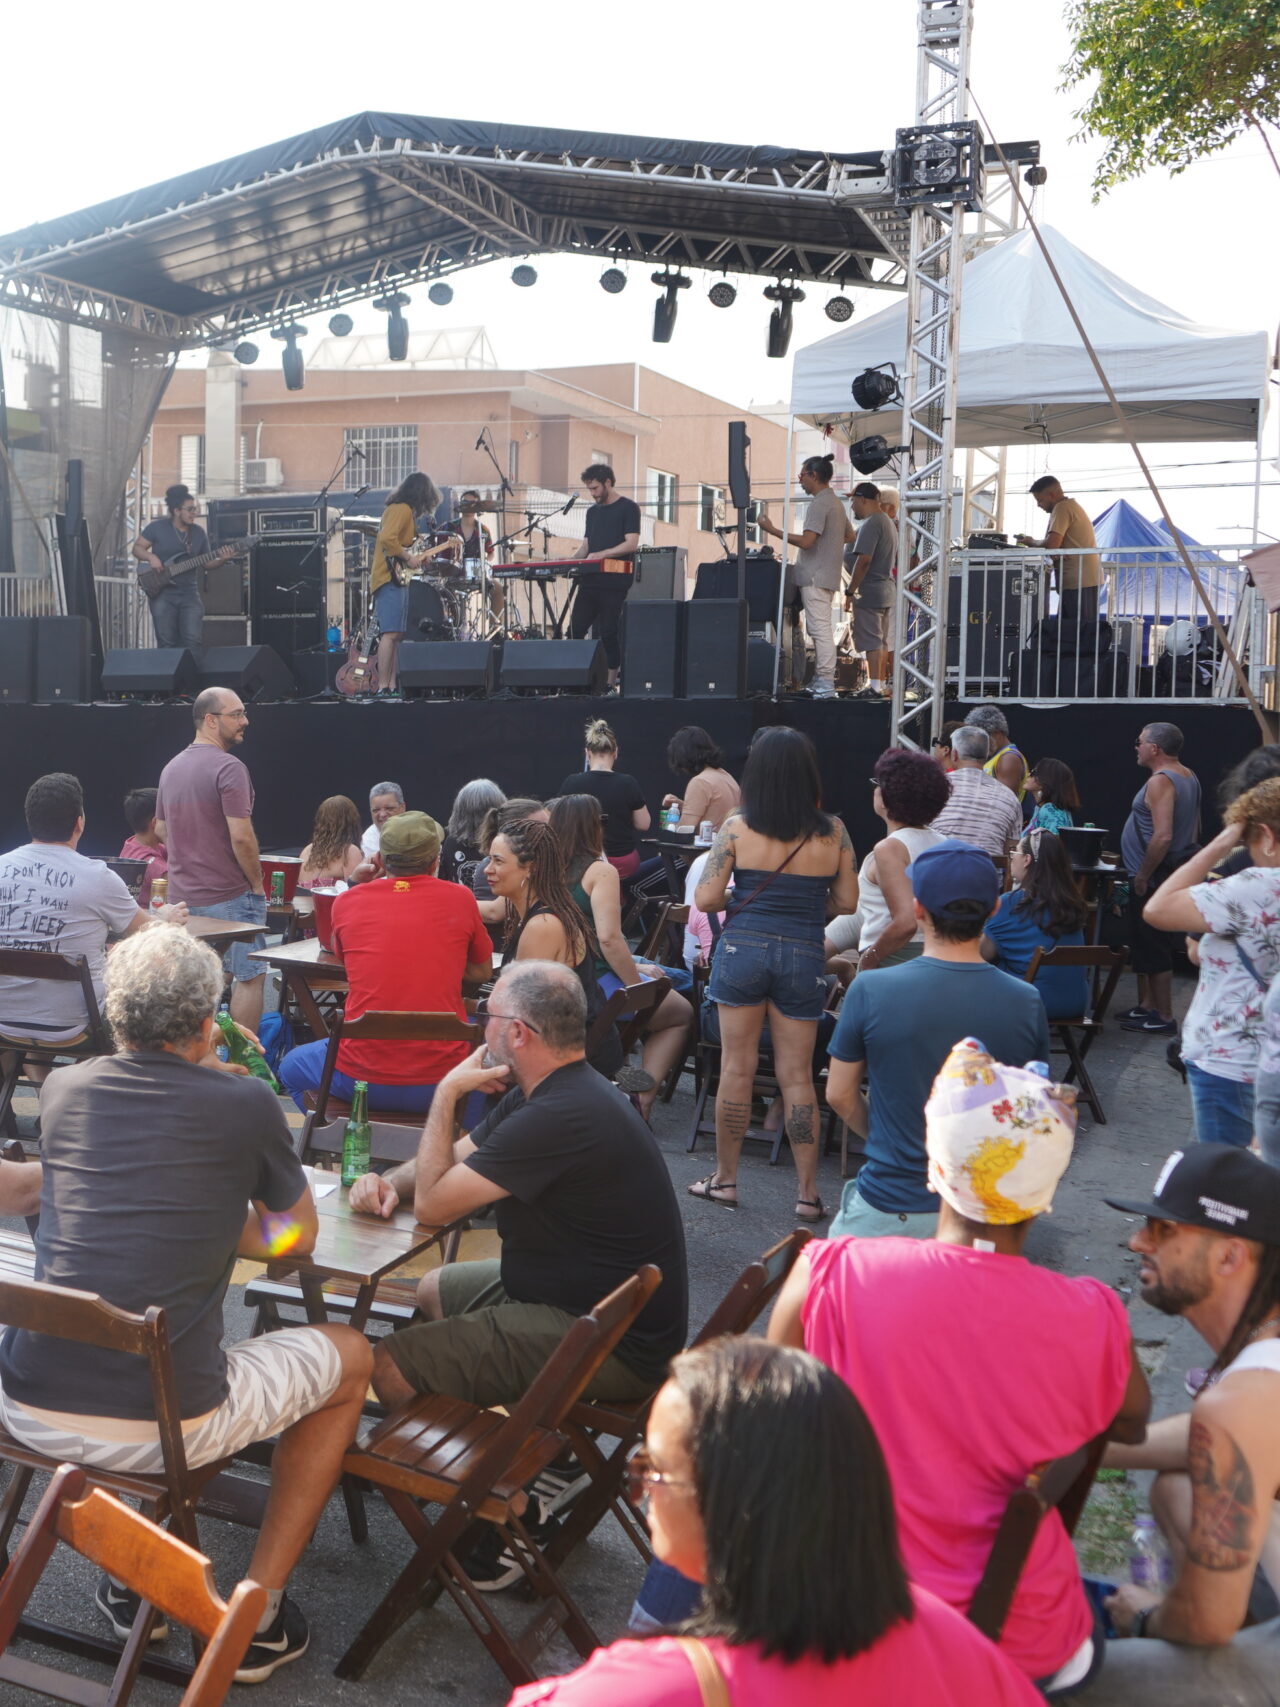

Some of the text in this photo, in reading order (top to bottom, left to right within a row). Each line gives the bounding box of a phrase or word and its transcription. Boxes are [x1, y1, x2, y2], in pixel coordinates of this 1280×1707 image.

[11, 862, 46, 880] DON'T
[44, 868, 76, 888] KNOW
[24, 888, 36, 903] I
[19, 912, 32, 930] I
[32, 915, 67, 938] NEED
